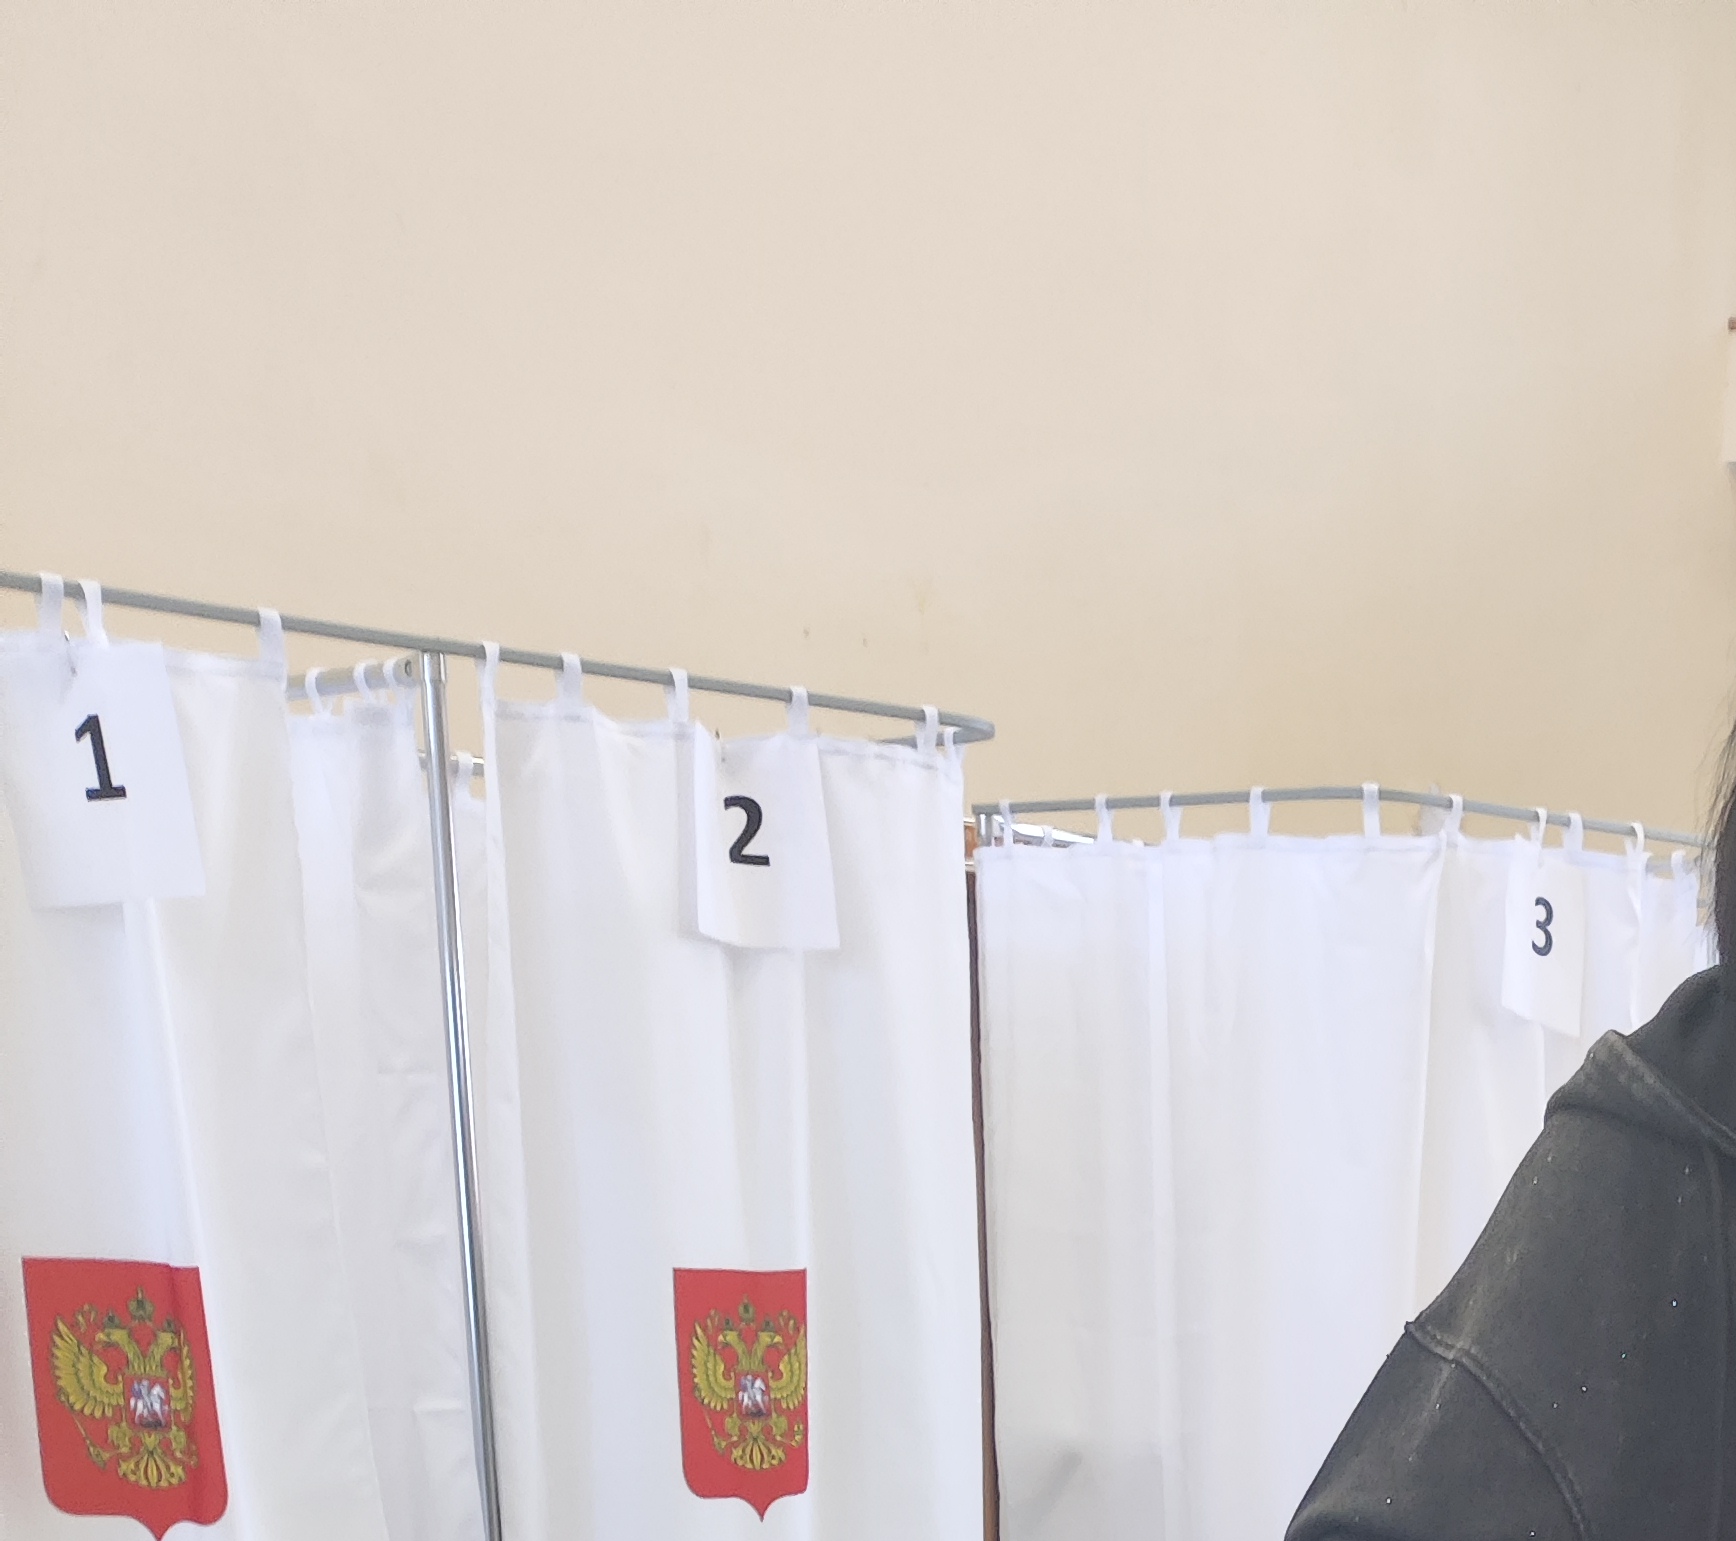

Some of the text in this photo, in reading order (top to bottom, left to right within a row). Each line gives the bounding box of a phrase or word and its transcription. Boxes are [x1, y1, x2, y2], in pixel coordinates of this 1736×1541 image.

[75, 714, 127, 801] 1
[723, 795, 771, 867] 2
[1531, 896, 1554, 957] 3
